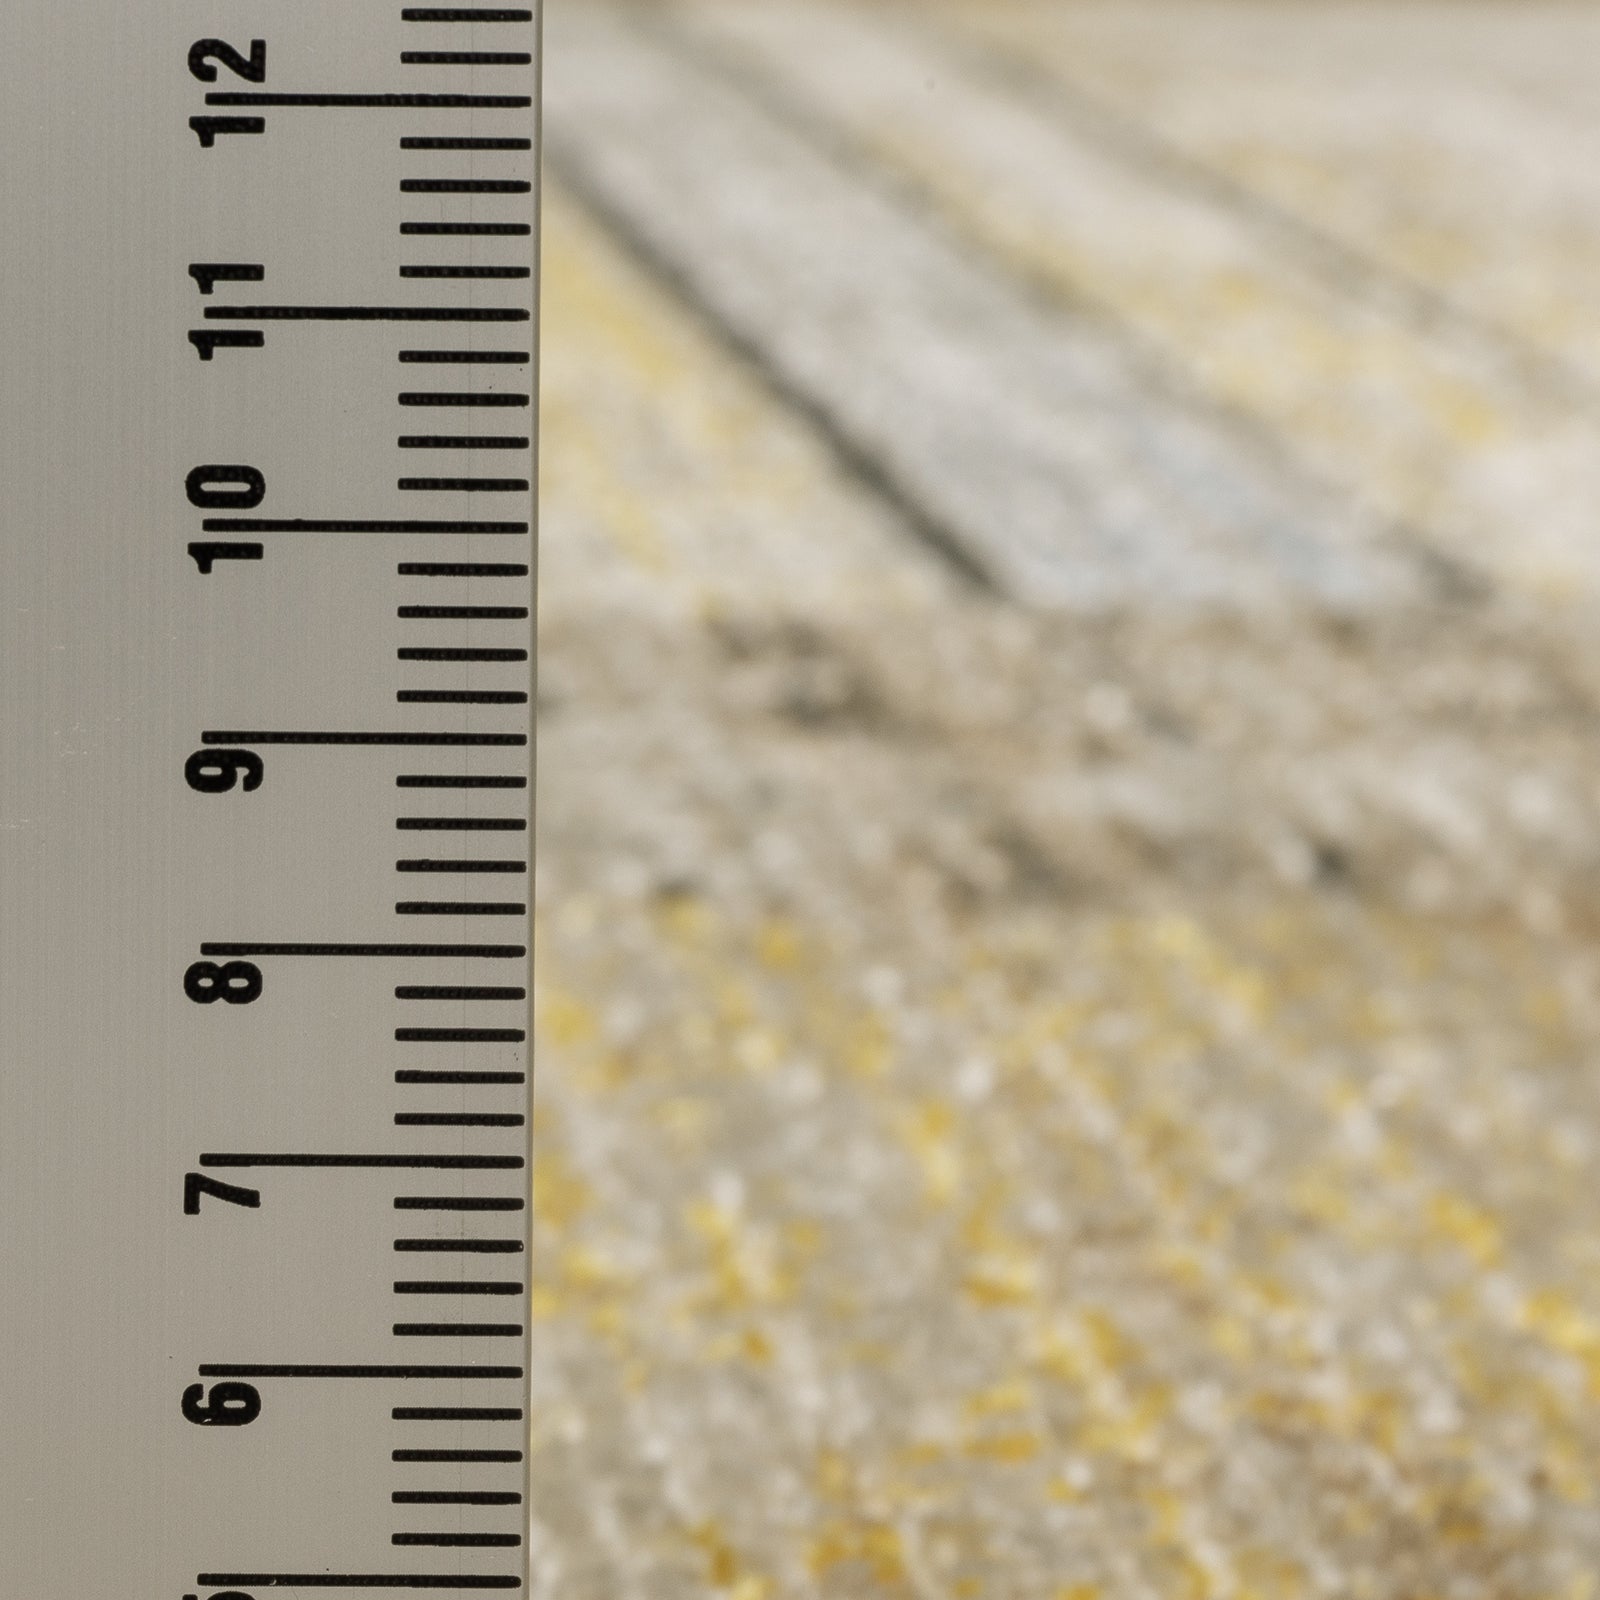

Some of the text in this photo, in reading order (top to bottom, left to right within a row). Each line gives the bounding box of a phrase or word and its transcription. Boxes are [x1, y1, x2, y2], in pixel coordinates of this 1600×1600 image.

[188, 38, 266, 148] 12
[188, 264, 265, 361] 11
[186, 464, 265, 574] 10
[184, 747, 264, 794] 9
[183, 960, 263, 1005] 8
[183, 1172, 261, 1216] 7
[180, 1381, 262, 1427] 6
